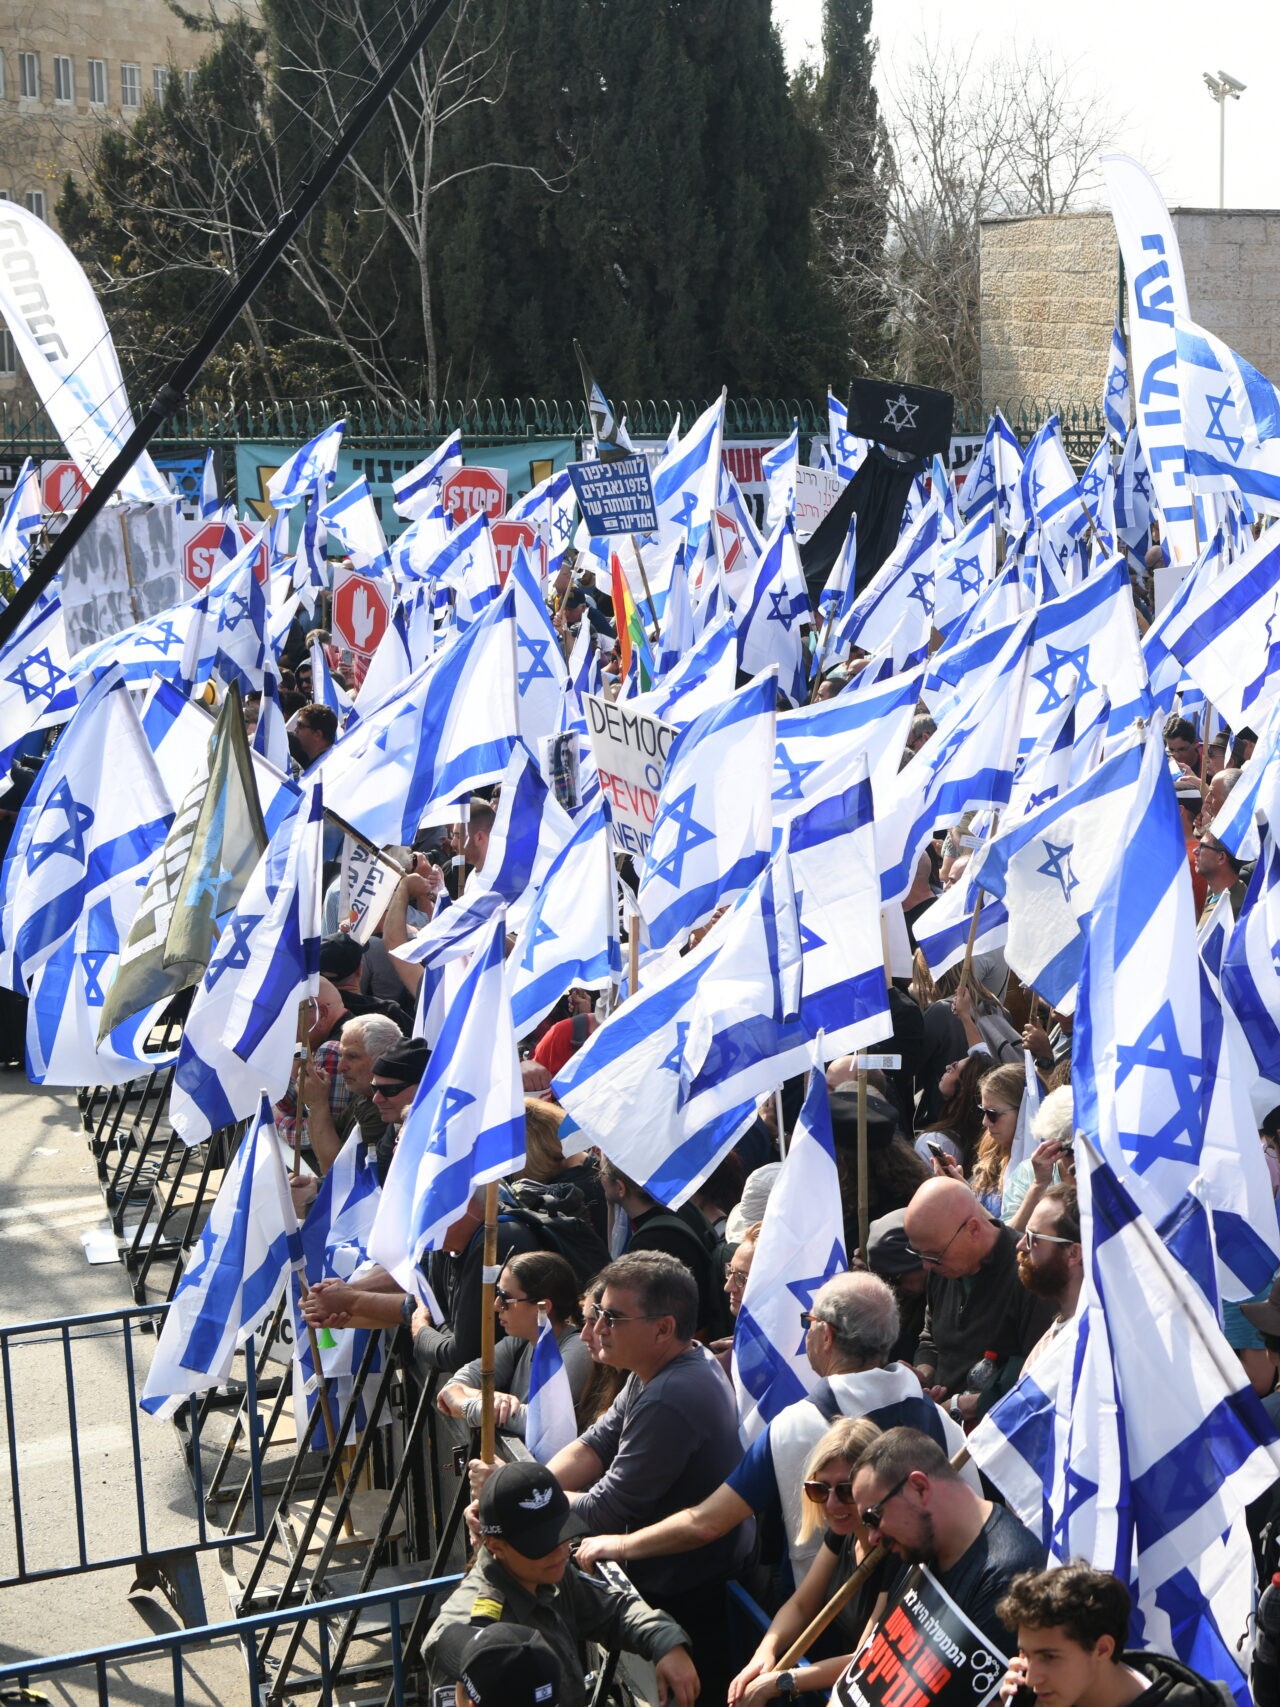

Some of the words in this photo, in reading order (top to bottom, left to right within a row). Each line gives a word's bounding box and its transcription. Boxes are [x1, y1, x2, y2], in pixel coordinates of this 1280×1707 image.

[578, 463, 612, 480] כיפור
[612, 457, 644, 475] לוחמי
[581, 480, 624, 498] נאבקים
[624, 477, 648, 493] 1973
[449, 486, 499, 511] STOP
[602, 496, 637, 513] דמותה
[636, 493, 651, 510] על
[582, 500, 602, 516] של
[619, 512, 655, 529] המדינה
[588, 698, 678, 761] DEMOC
[645, 763, 662, 791] O
[903, 1588, 918, 1607] לא
[911, 1600, 929, 1624] היא
[924, 1615, 966, 1668] הממשלה
